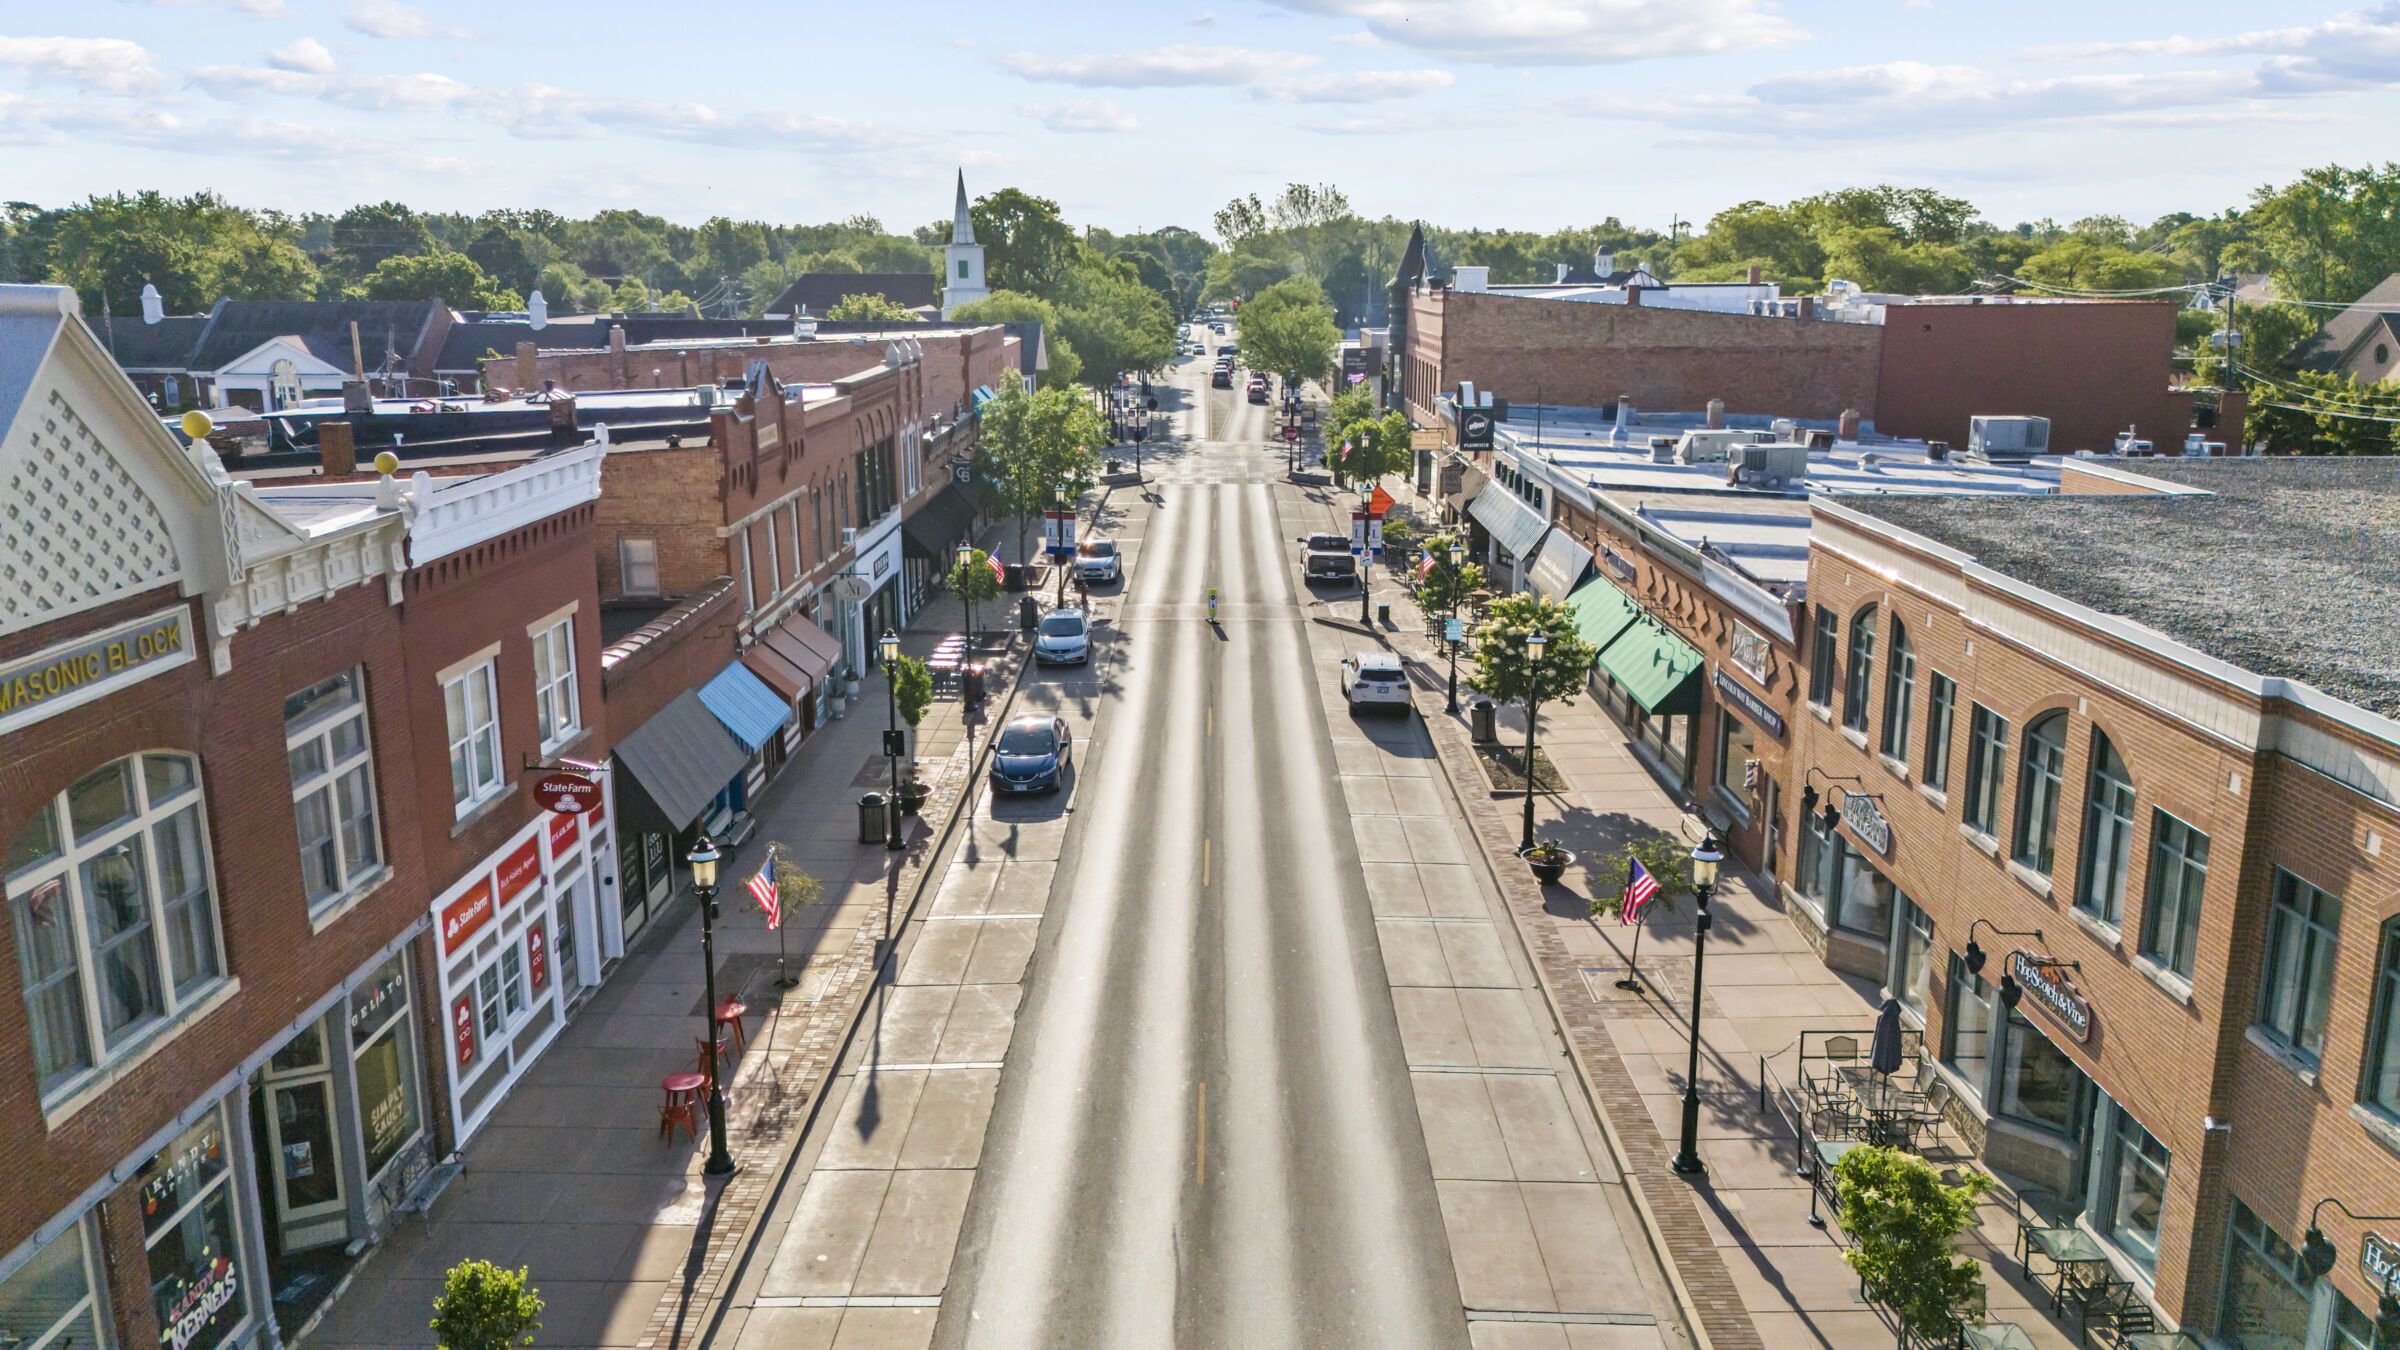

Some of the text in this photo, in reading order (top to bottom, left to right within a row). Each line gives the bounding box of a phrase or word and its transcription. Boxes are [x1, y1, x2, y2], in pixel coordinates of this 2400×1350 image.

[0, 624, 183, 712] MASONIC BLOCK
[1719, 674, 1737, 696] LINCOLN
[1745, 695, 1763, 718] BARBER
[1763, 709, 1777, 728] SHOP
[351, 975, 402, 1027] GELATO
[2016, 954, 2058, 1005] HopScotch
[2058, 993, 2067, 1011] &
[2066, 997, 2086, 1027] Vine
[371, 1083, 404, 1127] SIMPLY
[375, 1100, 403, 1140] SAUCY
[153, 1135, 209, 1193] KANDY
[170, 1269, 214, 1325] KANDY
[171, 1261, 237, 1350] KERNELS
